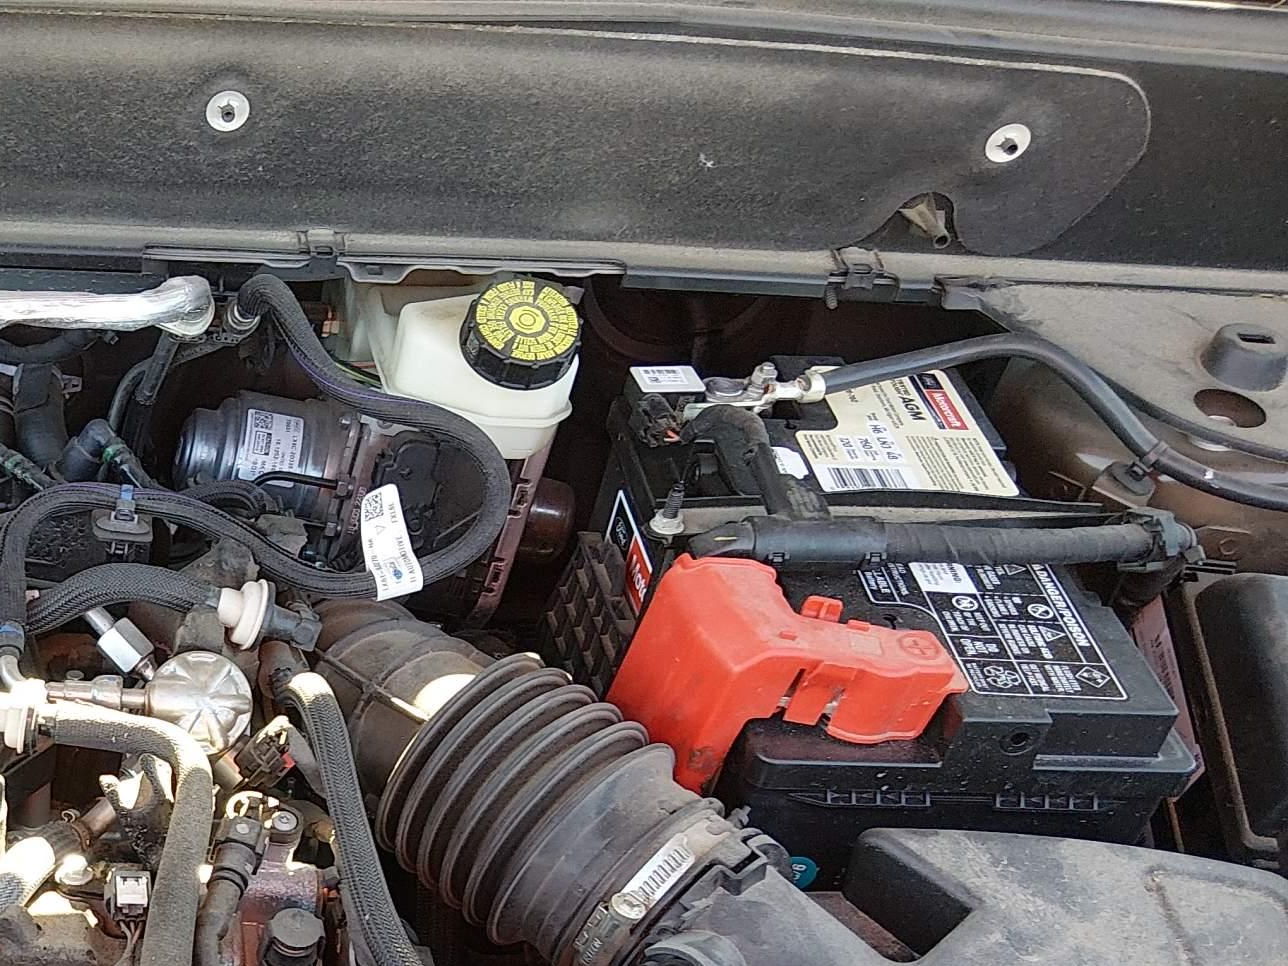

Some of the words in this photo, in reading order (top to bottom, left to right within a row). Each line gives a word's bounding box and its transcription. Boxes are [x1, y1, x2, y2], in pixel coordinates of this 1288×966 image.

[898, 394, 926, 421] AGM
[931, 391, 963, 427] Motorcraft
[1034, 571, 1090, 646] DANGER/POISON
